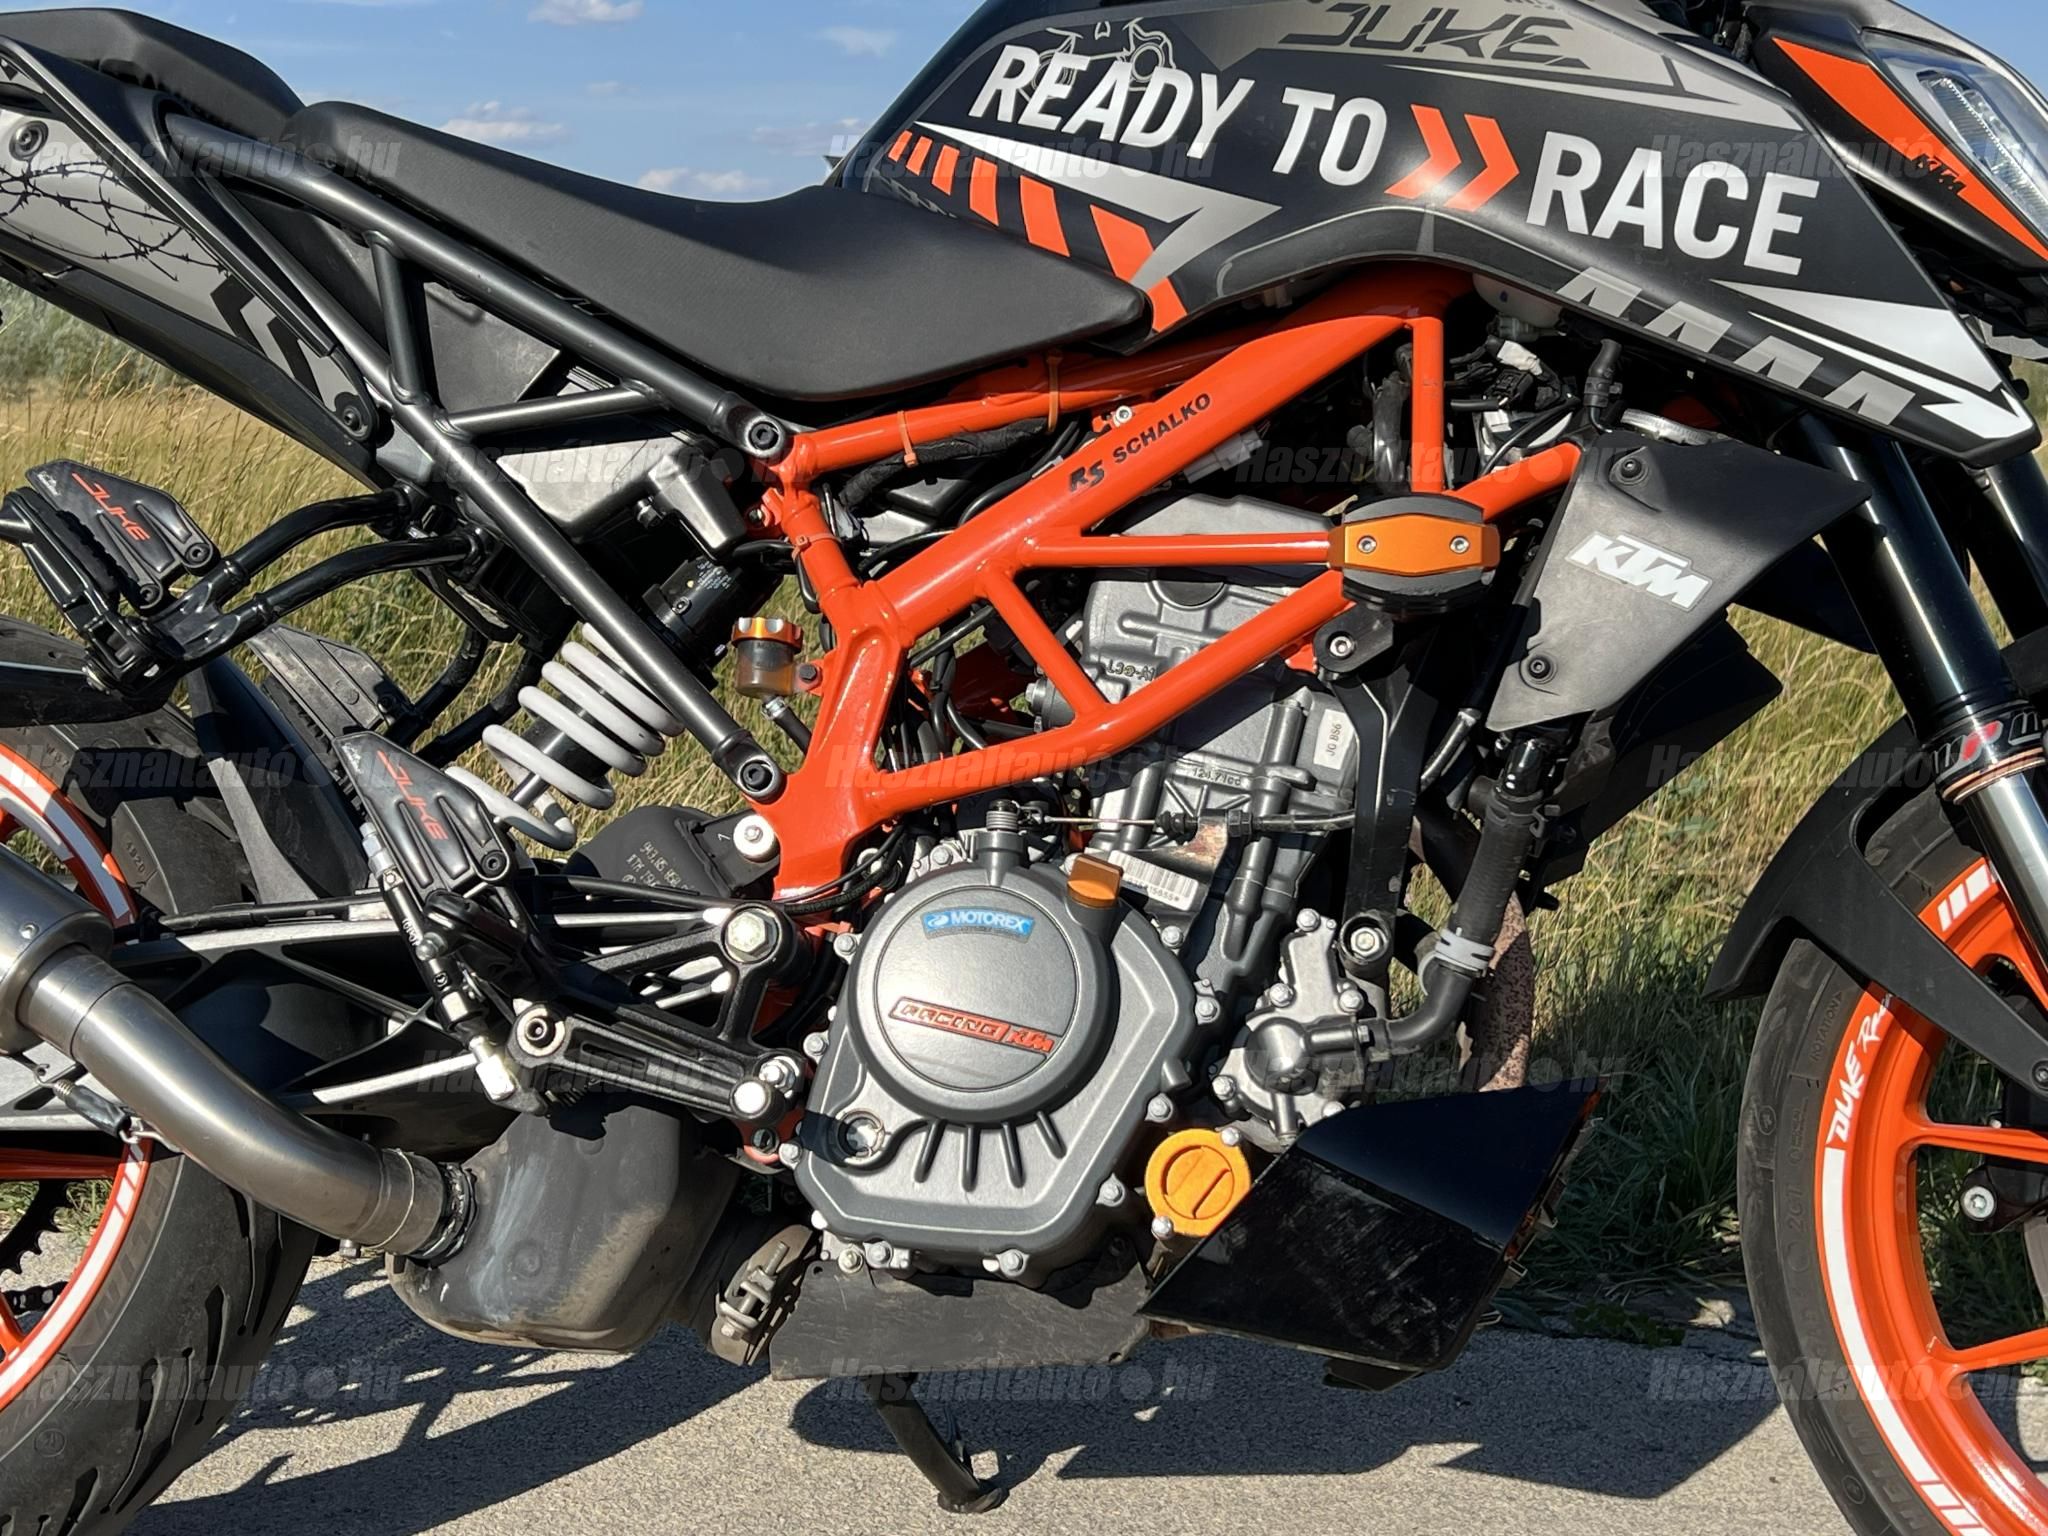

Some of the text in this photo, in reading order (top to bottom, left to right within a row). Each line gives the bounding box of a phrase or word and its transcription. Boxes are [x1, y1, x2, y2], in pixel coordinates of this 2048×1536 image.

[968, 43, 1820, 276] READY TO RACE
[1067, 392, 1212, 493] RS SCHALKO
[1566, 531, 1713, 610] KTM
[949, 909, 1031, 935] MOTOREX
[1826, 1039, 1865, 1145] DUKE
